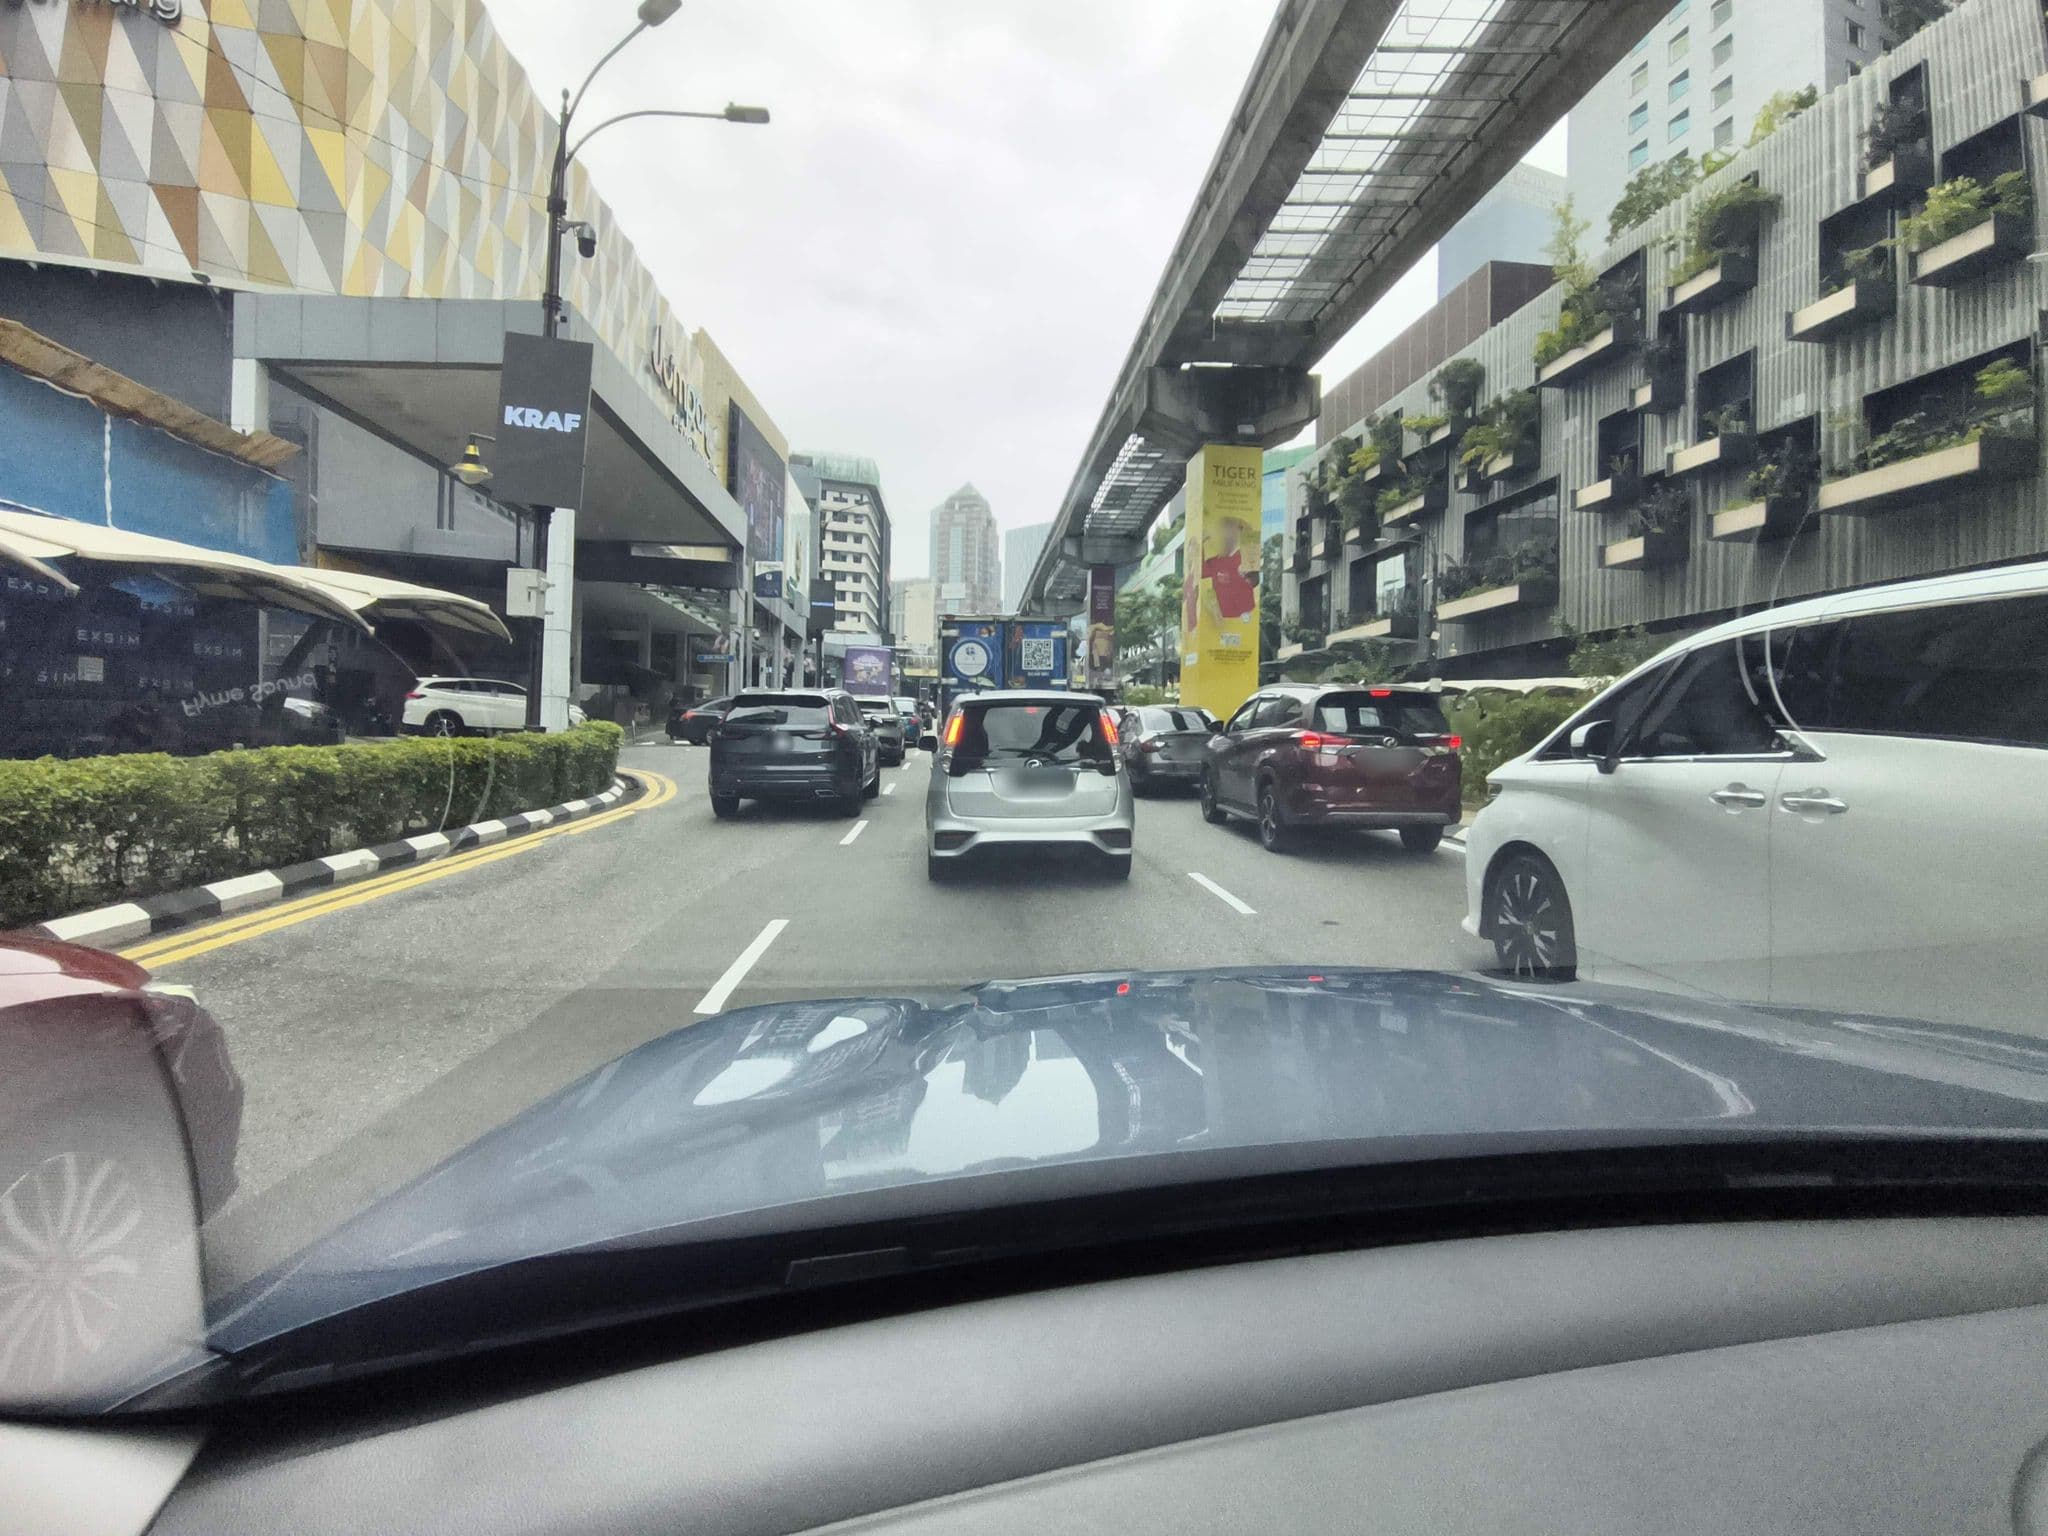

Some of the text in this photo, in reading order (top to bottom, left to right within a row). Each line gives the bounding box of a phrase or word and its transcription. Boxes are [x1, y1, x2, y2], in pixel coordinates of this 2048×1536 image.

[503, 405, 582, 433] KRAF
[1212, 464, 1257, 480] TIGER
[76, 628, 140, 646] EXSIM
